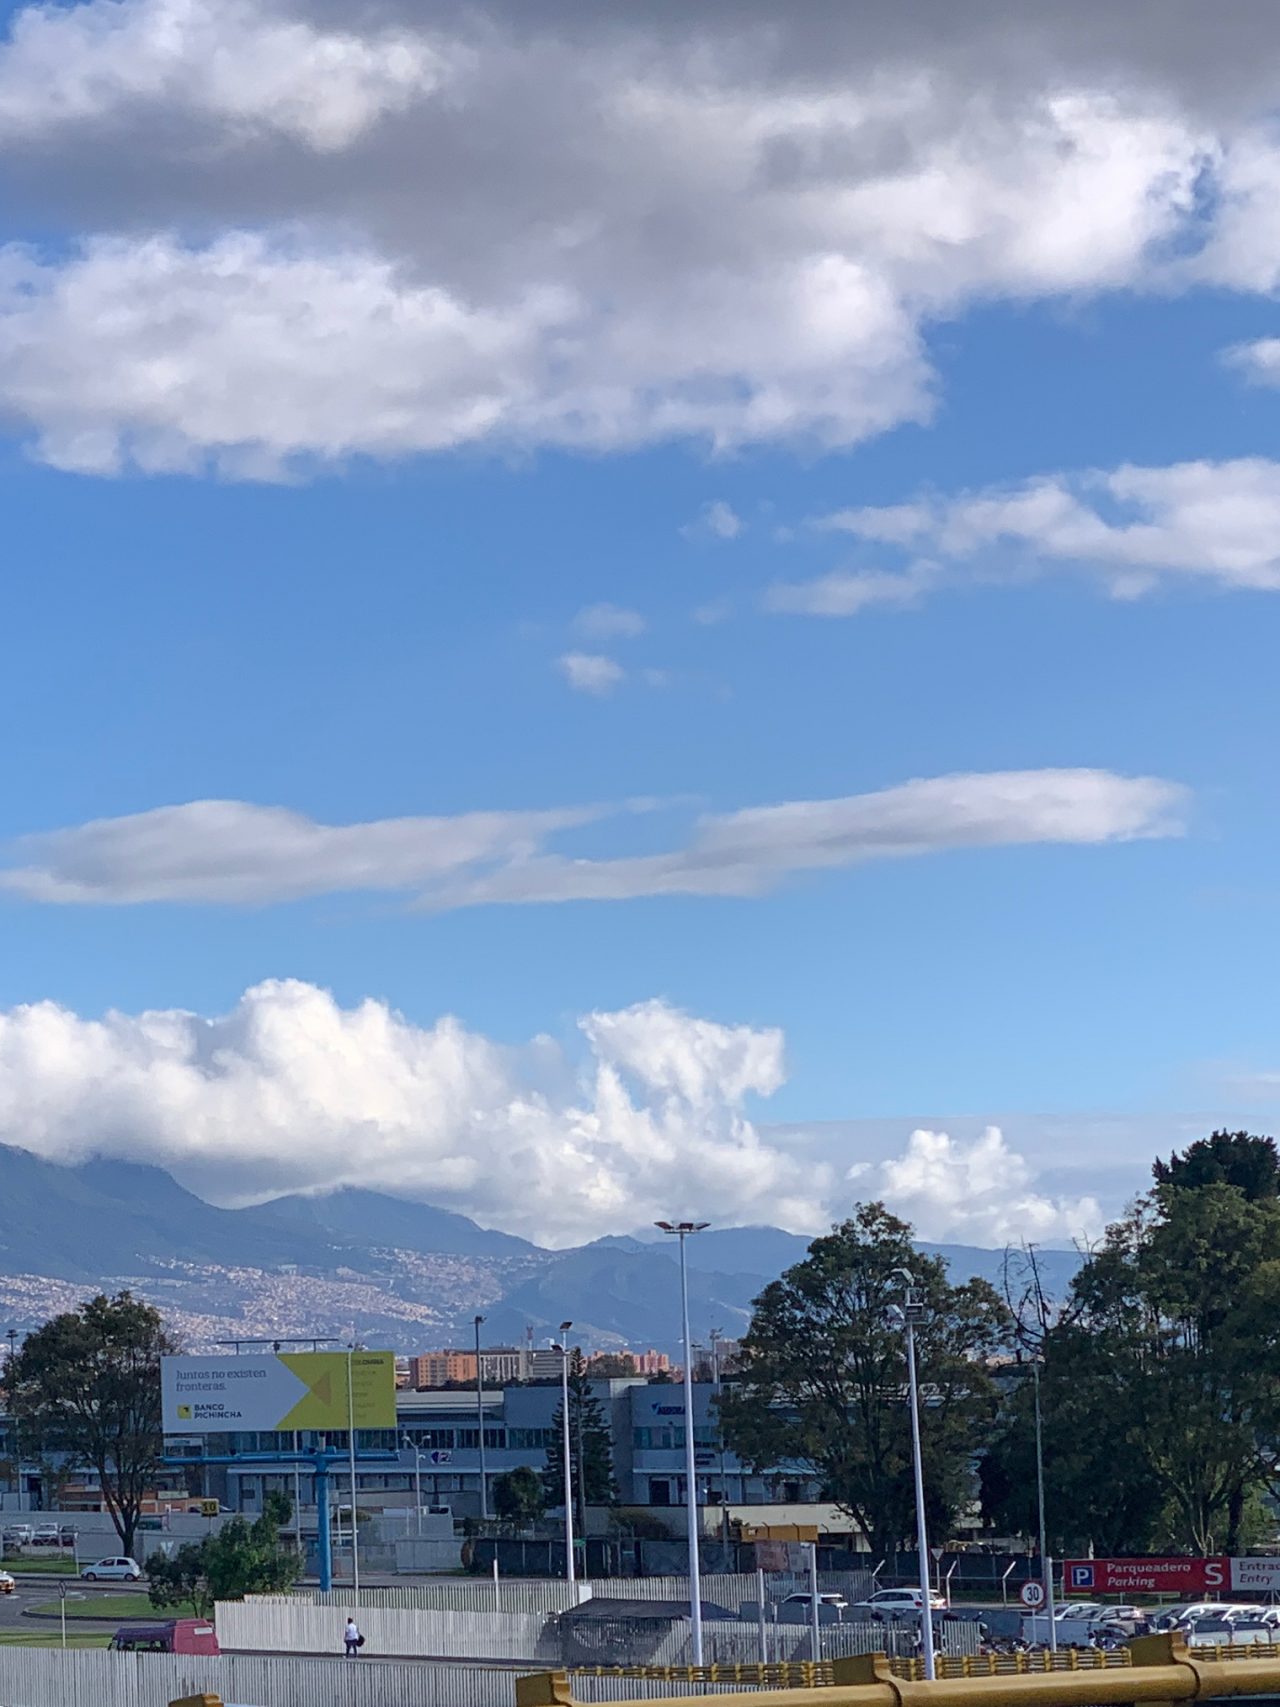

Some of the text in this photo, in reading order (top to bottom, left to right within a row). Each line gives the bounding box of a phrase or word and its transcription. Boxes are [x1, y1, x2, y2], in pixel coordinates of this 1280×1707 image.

[176, 1369, 267, 1380] Juntos no existen
[176, 1382, 227, 1392] fronteras.
[194, 1403, 225, 1411] BANCO
[194, 1411, 243, 1419] PICHINCHA
[1107, 1563, 1191, 1575] Parqueadero
[1204, 1563, 1223, 1585] S
[1076, 1568, 1089, 1585] P
[1107, 1576, 1156, 1588] Parking
[1239, 1573, 1273, 1585] Entry
[1026, 1586, 1040, 1602] 30
